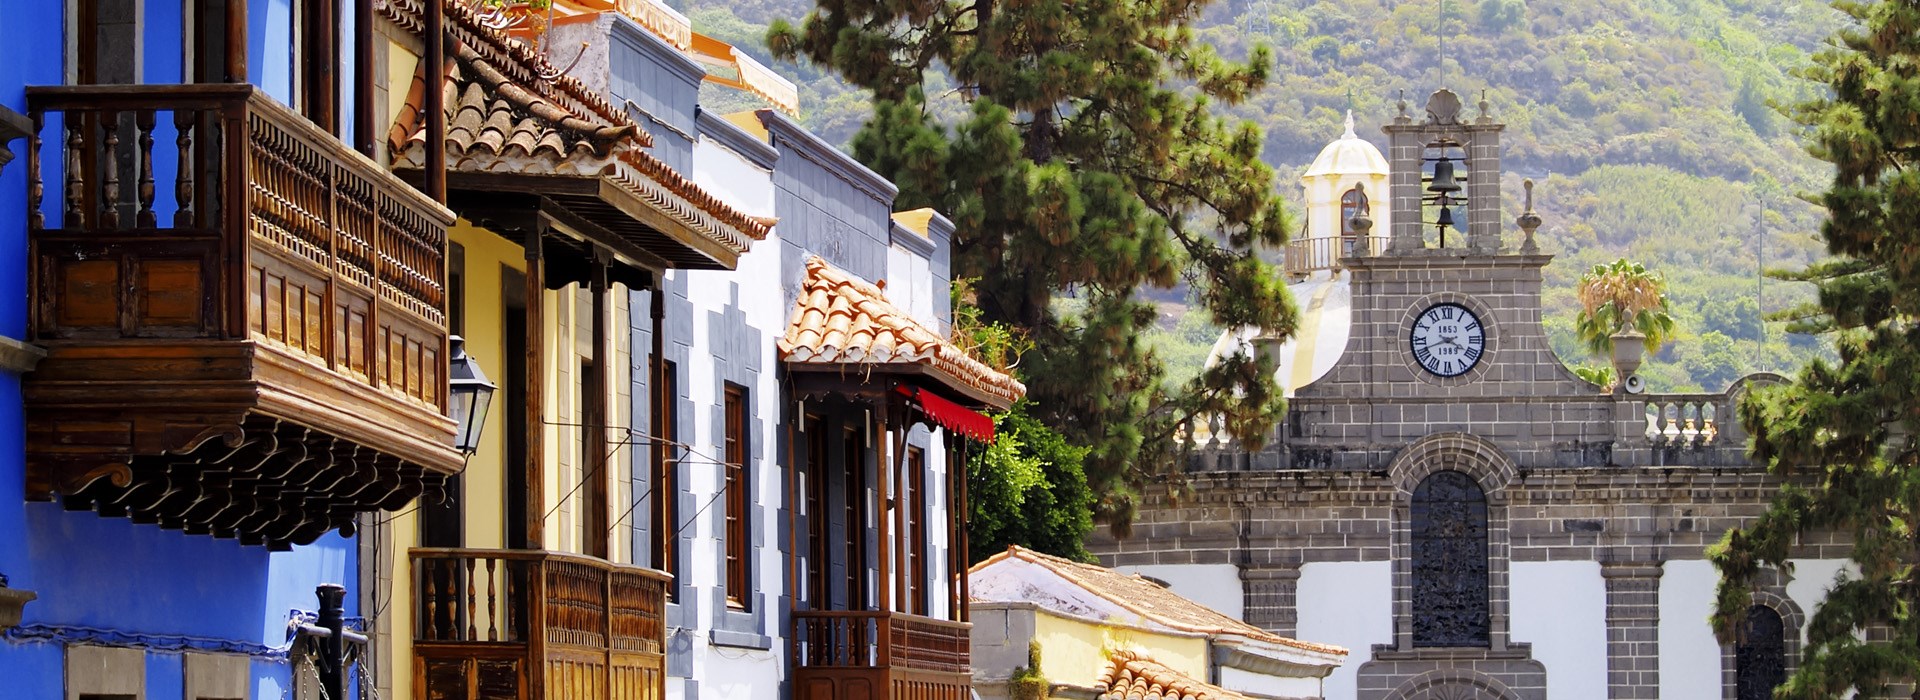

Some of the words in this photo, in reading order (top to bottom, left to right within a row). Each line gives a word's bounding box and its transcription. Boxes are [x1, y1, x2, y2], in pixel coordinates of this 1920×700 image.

[1427, 310, 1440, 324] XI
[1442, 308, 1452, 319] XII
[1457, 310, 1465, 322] I
[1417, 321, 1430, 332] X
[1465, 321, 1477, 332] II
[1415, 336, 1426, 345] IX
[1469, 336, 1480, 344] III
[1417, 347, 1431, 363] VIII
[1464, 347, 1478, 360] IIII
[1428, 356, 1440, 370] VII
[1444, 362, 1452, 373] VI
[1458, 359, 1467, 370] V
